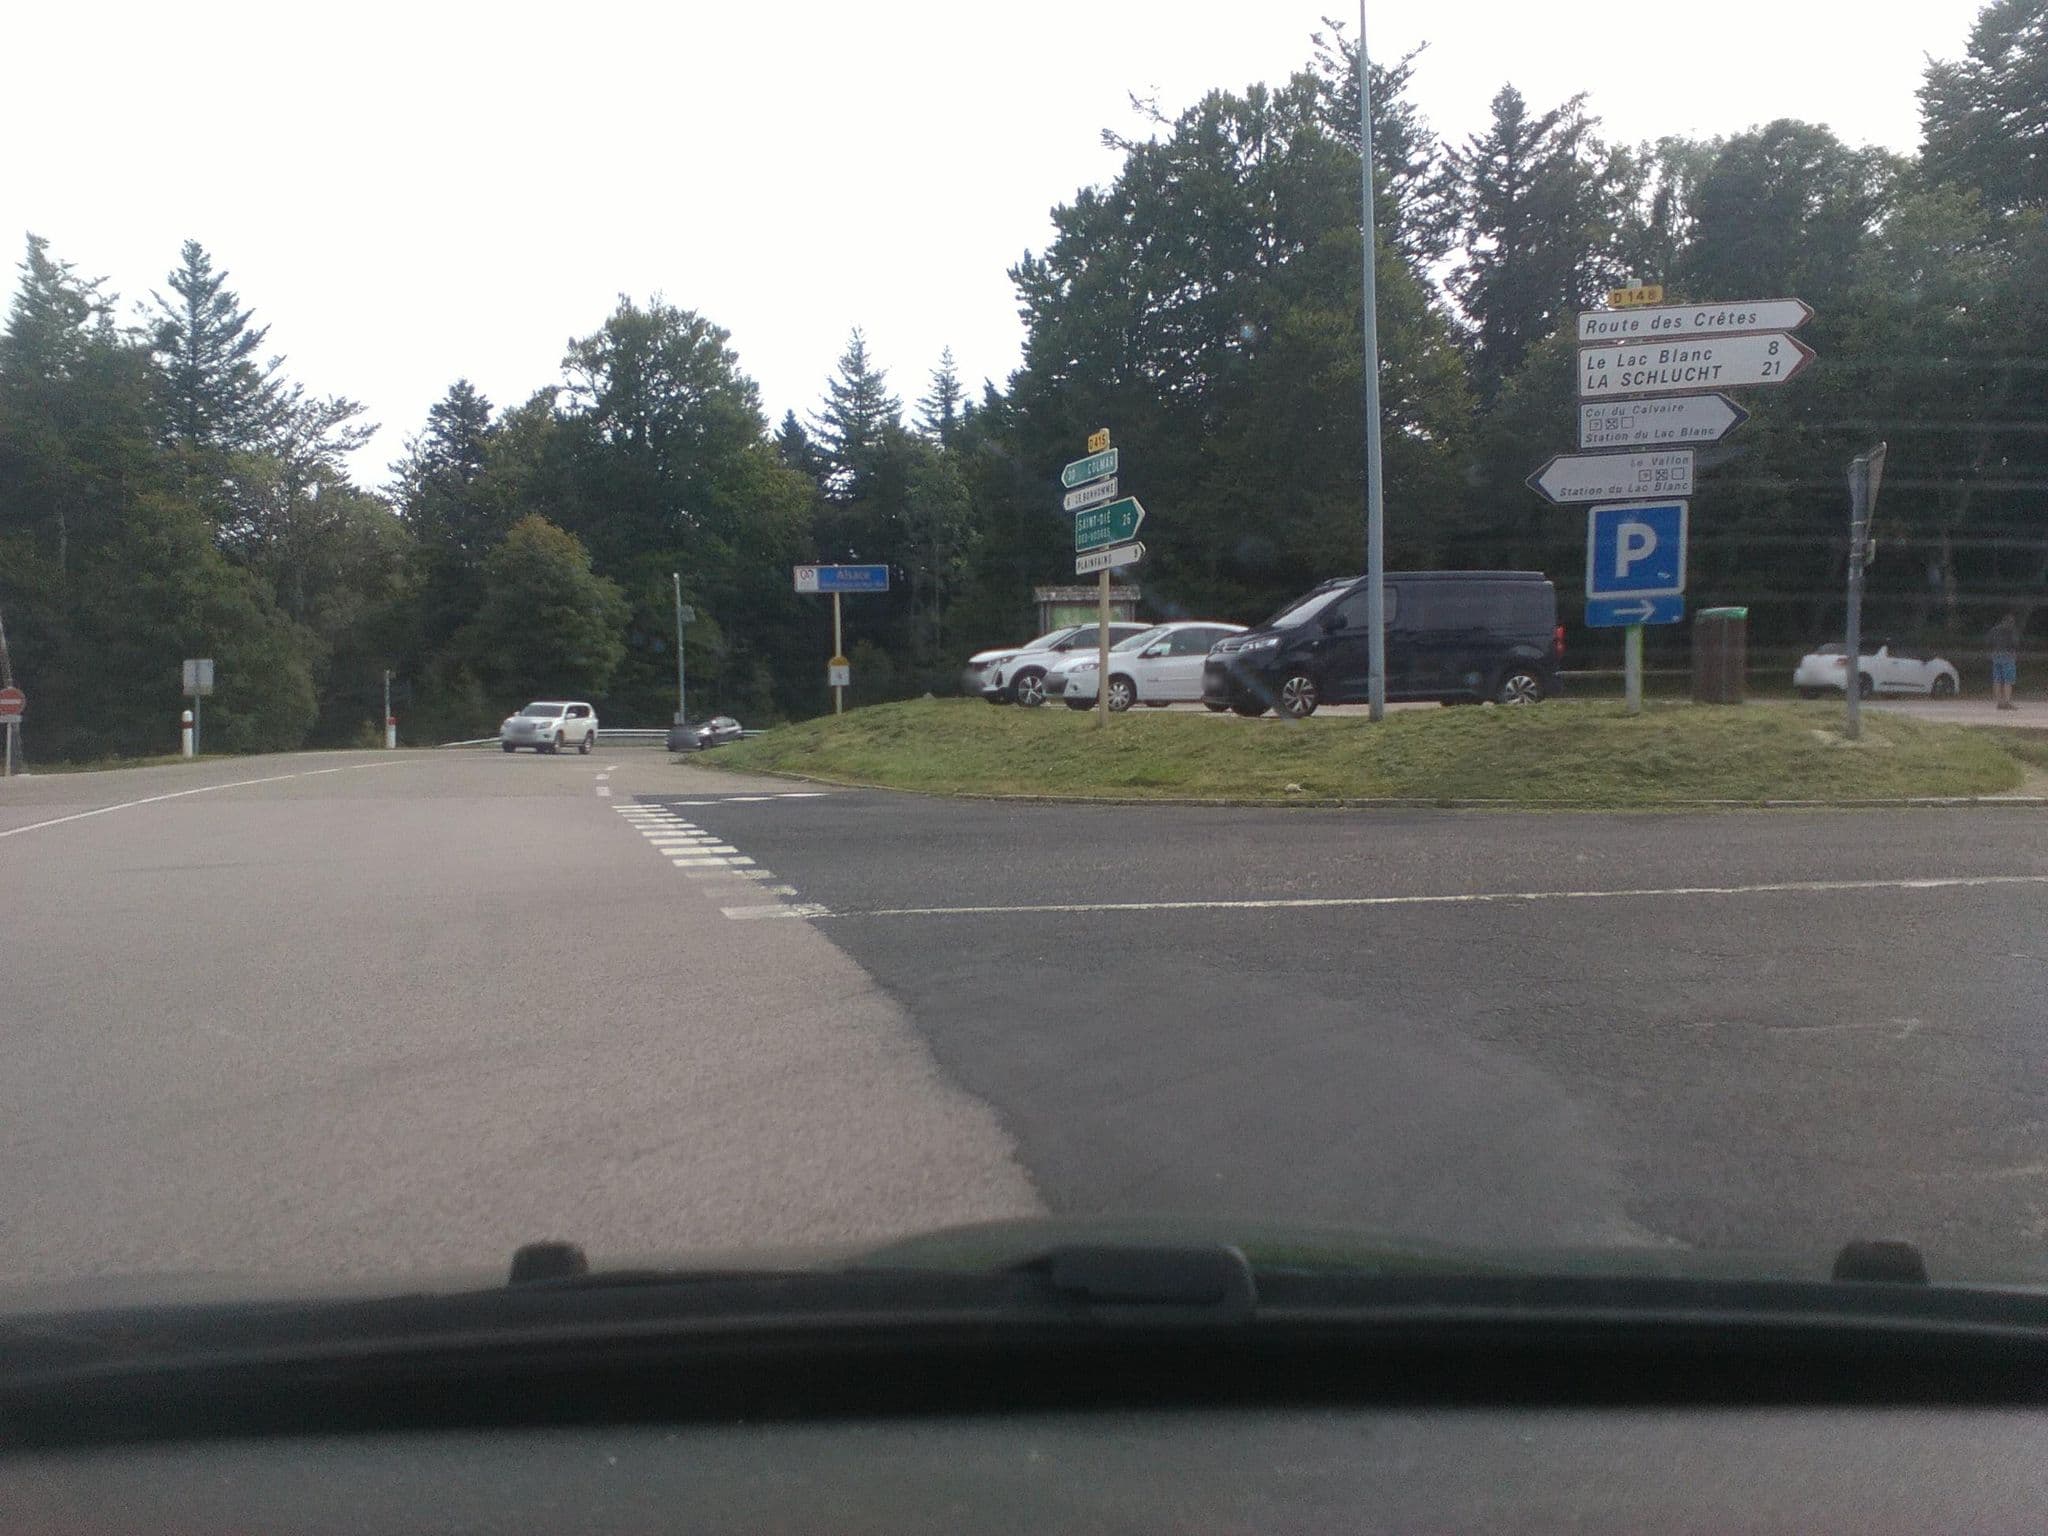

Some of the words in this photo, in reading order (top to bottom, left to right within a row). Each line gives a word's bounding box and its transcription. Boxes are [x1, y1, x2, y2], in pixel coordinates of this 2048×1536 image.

[1614, 293, 1622, 304] D
[1586, 319, 1639, 334] Route
[1651, 315, 1682, 330] des
[1694, 311, 1757, 326] Crêtes
[1587, 356, 1606, 370] Le
[1617, 353, 1647, 368] Lac
[1659, 349, 1713, 364] Blanc
[1768, 341, 1779, 355] 8
[1587, 374, 1608, 389] LA
[1621, 365, 1722, 386] SCHLUCHT
[1761, 361, 1780, 376] 21
[1586, 408, 1606, 418] Col
[1612, 406, 1626, 416] du
[1632, 404, 1684, 414] Calvaire
[1586, 432, 1628, 442] Station
[1634, 430, 1648, 440] du
[1654, 428, 1674, 438] Lac
[1680, 427, 1715, 437] Blanc
[1560, 487, 1603, 497] Station
[1609, 484, 1622, 494] du
[1628, 483, 1648, 493] Lac
[1654, 481, 1688, 492] Blanc
[1615, 524, 1657, 578] P
